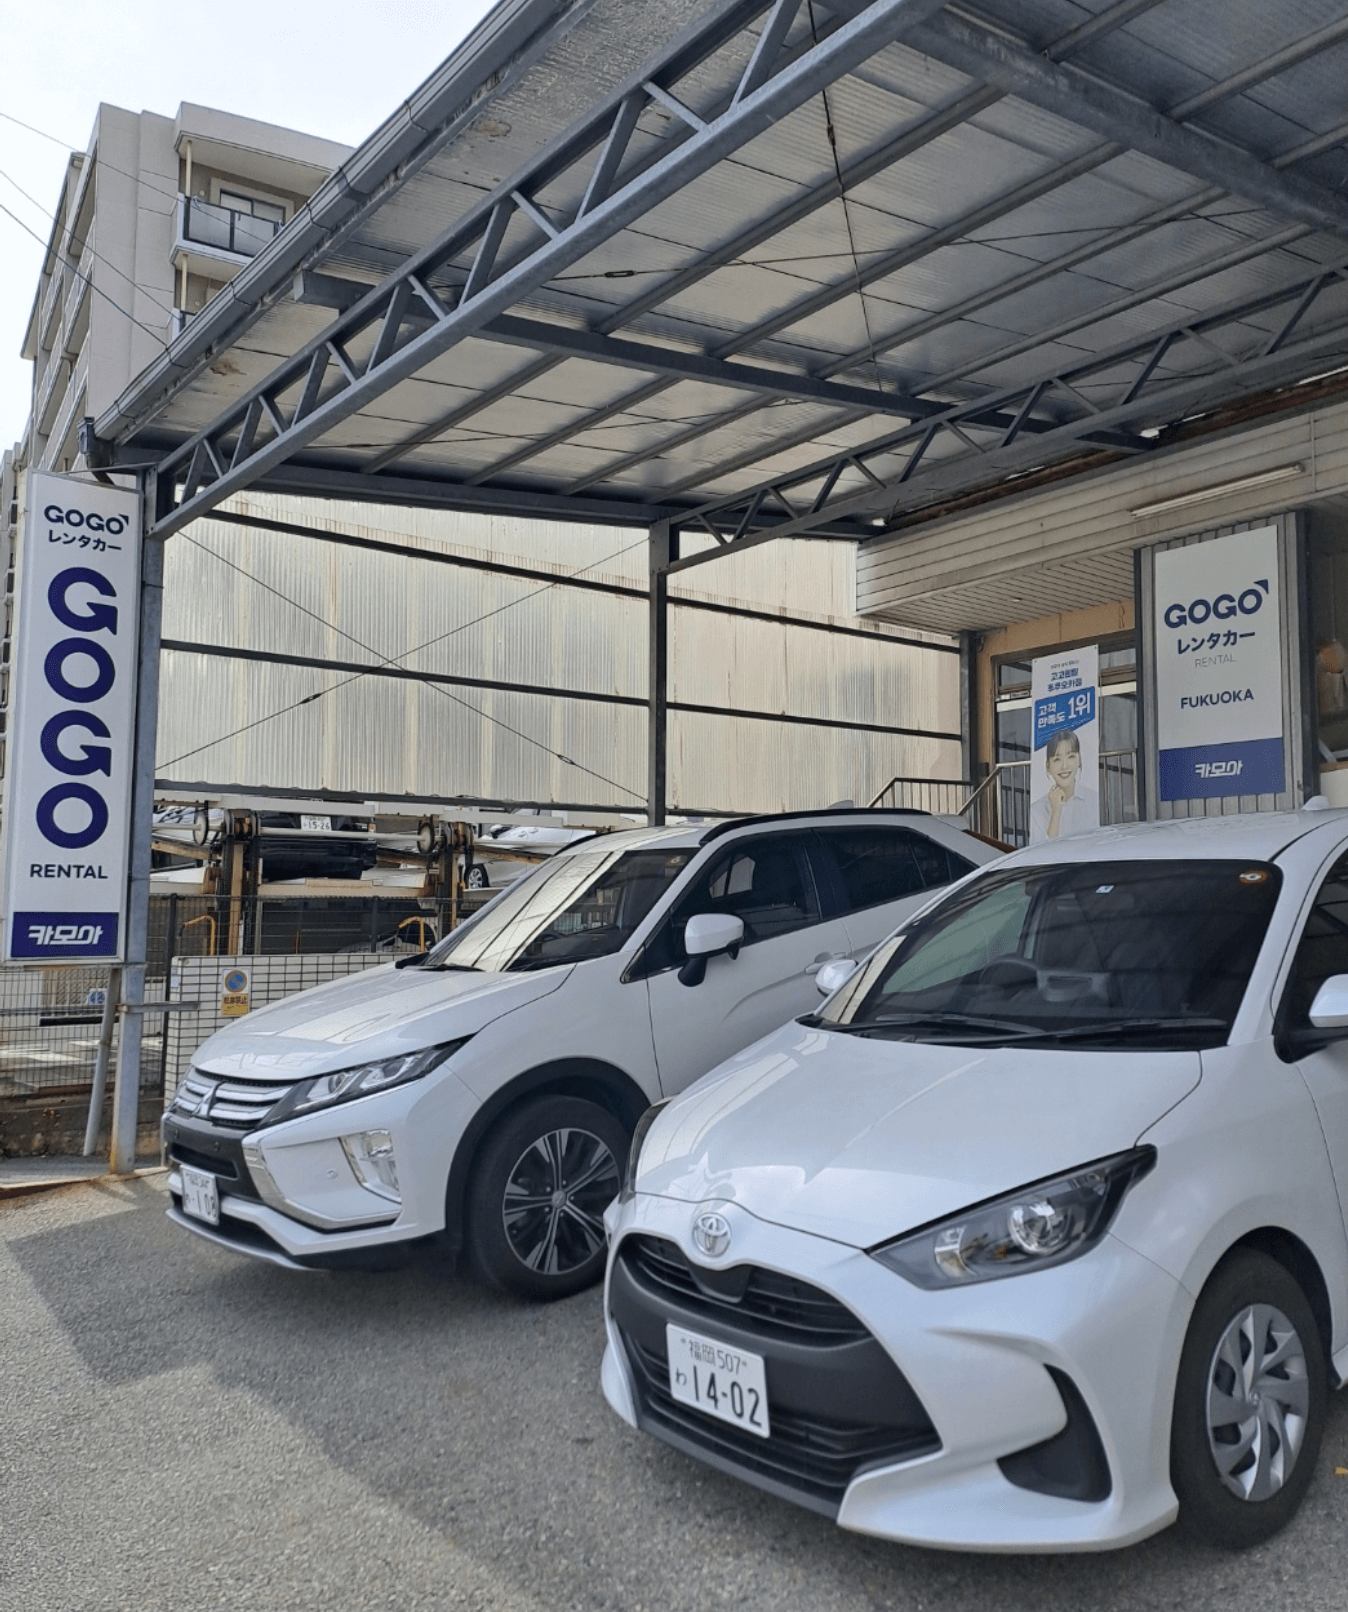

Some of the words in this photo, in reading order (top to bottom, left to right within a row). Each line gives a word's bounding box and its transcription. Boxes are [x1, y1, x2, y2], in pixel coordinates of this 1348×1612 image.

[44, 505, 124, 535] GOGO
[49, 529, 122, 552] レンタカー
[1164, 588, 1263, 628] GOGO
[1177, 629, 1256, 655] レンタカー
[1195, 654, 1237, 668] RENTAL
[36, 567, 118, 849] GOGO
[1068, 692, 1091, 719] 1위
[1180, 689, 1254, 709] FUKUOKA
[1194, 760, 1243, 779] 카모아
[30, 863, 109, 879] RENTAL
[28, 925, 104, 946] 카모아
[689, 1340, 717, 1367] 福岡
[716, 1349, 741, 1375] 507
[675, 1366, 688, 1387] わ
[692, 1364, 763, 1429] 14-02
